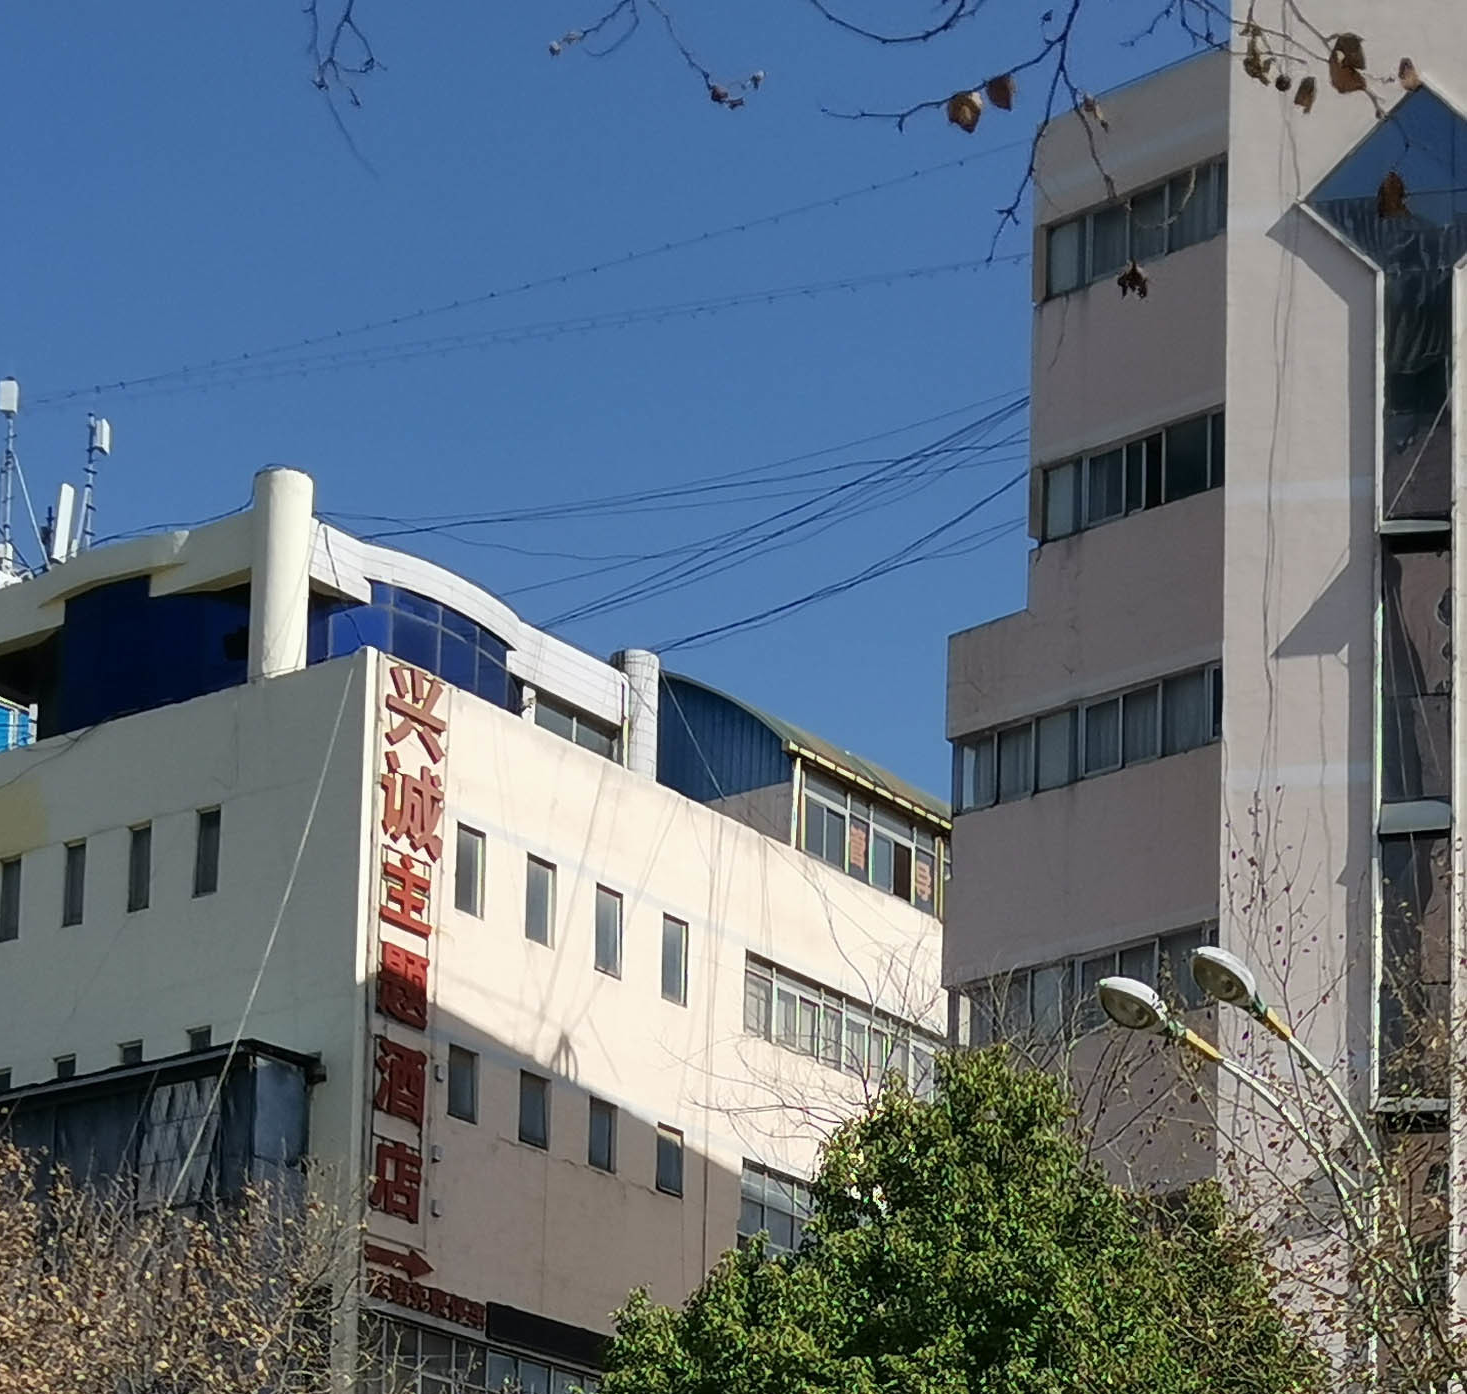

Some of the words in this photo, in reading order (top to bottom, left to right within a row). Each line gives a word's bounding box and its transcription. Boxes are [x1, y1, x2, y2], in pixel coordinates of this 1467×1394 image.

[369, 665, 448, 1224] 兴诚主题酒店
